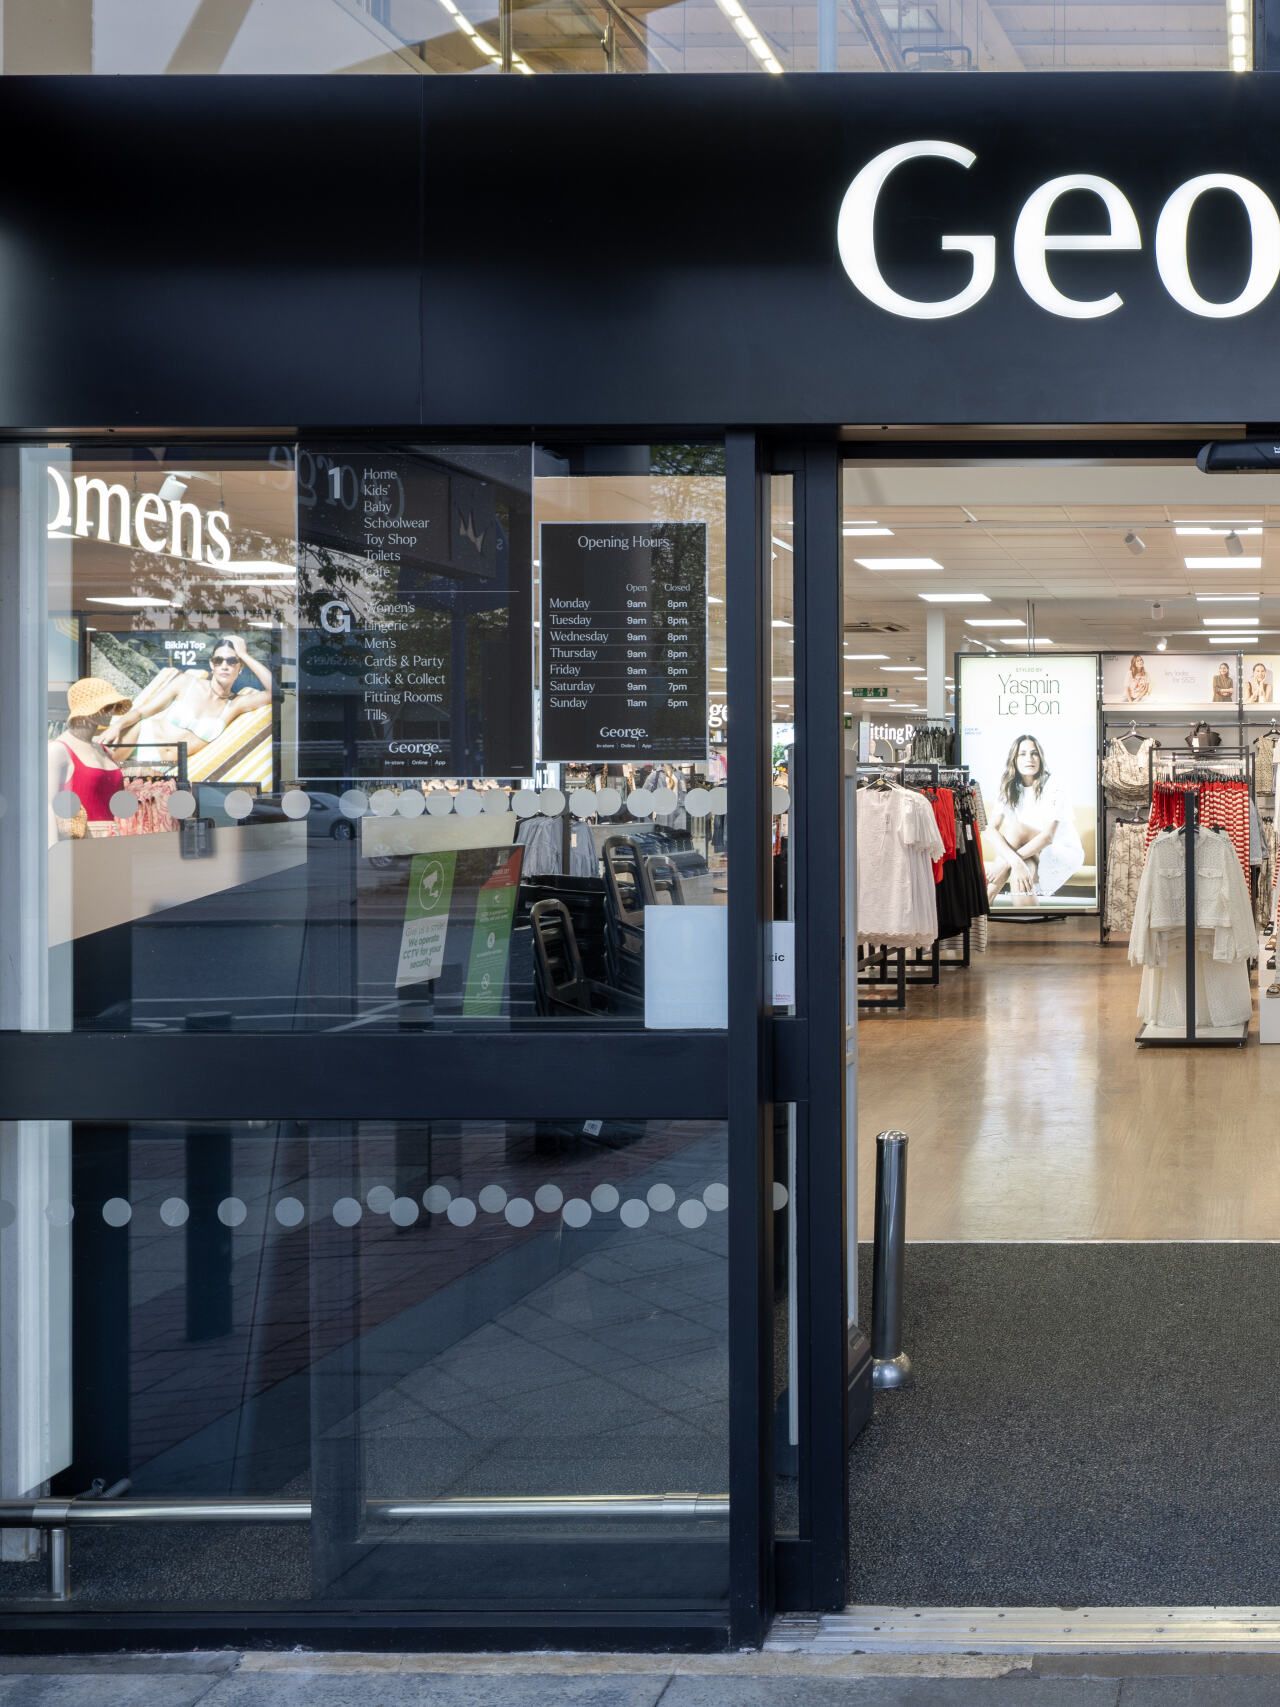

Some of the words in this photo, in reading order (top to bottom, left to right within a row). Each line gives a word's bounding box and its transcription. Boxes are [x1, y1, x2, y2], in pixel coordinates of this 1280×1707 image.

[363, 468, 398, 480] Home
[328, 466, 341, 499] 1
[363, 501, 393, 516] Baby
[363, 517, 430, 529] Schoolwear
[364, 533, 384, 548] Toy
[387, 533, 417, 548] Shop
[577, 535, 630, 550] Opening
[632, 535, 670, 548] Hours
[364, 550, 401, 561] Toilets
[626, 583, 648, 593] Open
[664, 583, 691, 592] Closed
[365, 602, 416, 614] Women's
[549, 598, 591, 611] Monday
[627, 600, 647, 608] 9am
[667, 600, 688, 610] 8pm
[321, 600, 351, 634] G
[549, 614, 592, 627] Tuesday
[627, 617, 647, 625] 9am
[667, 617, 688, 627] 8pm
[364, 619, 409, 633] Lingerie
[364, 637, 397, 649] Men's
[549, 631, 609, 643] Wednesday
[627, 633, 647, 641] 9am
[667, 633, 688, 643] 8pm
[164, 640, 189, 650] Bikini
[190, 640, 207, 651] Top
[174, 650, 198, 666] £12
[549, 647, 598, 660] Thursday
[627, 650, 647, 658] 9am
[667, 650, 688, 660] 8pm
[364, 655, 398, 668] Cards
[400, 656, 410, 667] &
[413, 655, 445, 669] Party
[549, 664, 581, 677] Friday
[627, 667, 647, 675] 9am
[667, 667, 688, 676] 8pm
[364, 673, 391, 685] Click
[394, 673, 404, 685] &
[407, 673, 446, 685] Collect
[998, 673, 1061, 695] Yasmin
[549, 680, 596, 693] Saturday
[627, 683, 647, 691] 9am
[667, 683, 688, 693] 7pm
[364, 691, 401, 705] Fitting
[403, 692, 443, 703] Rooms
[549, 697, 588, 710] Sunday
[627, 699, 647, 707] 11am
[667, 699, 688, 709] 5pm
[998, 695, 1019, 716] Le
[1025, 694, 1061, 715] Bon
[364, 708, 388, 721] Tills
[600, 726, 649, 741] George.
[388, 741, 443, 757] George.
